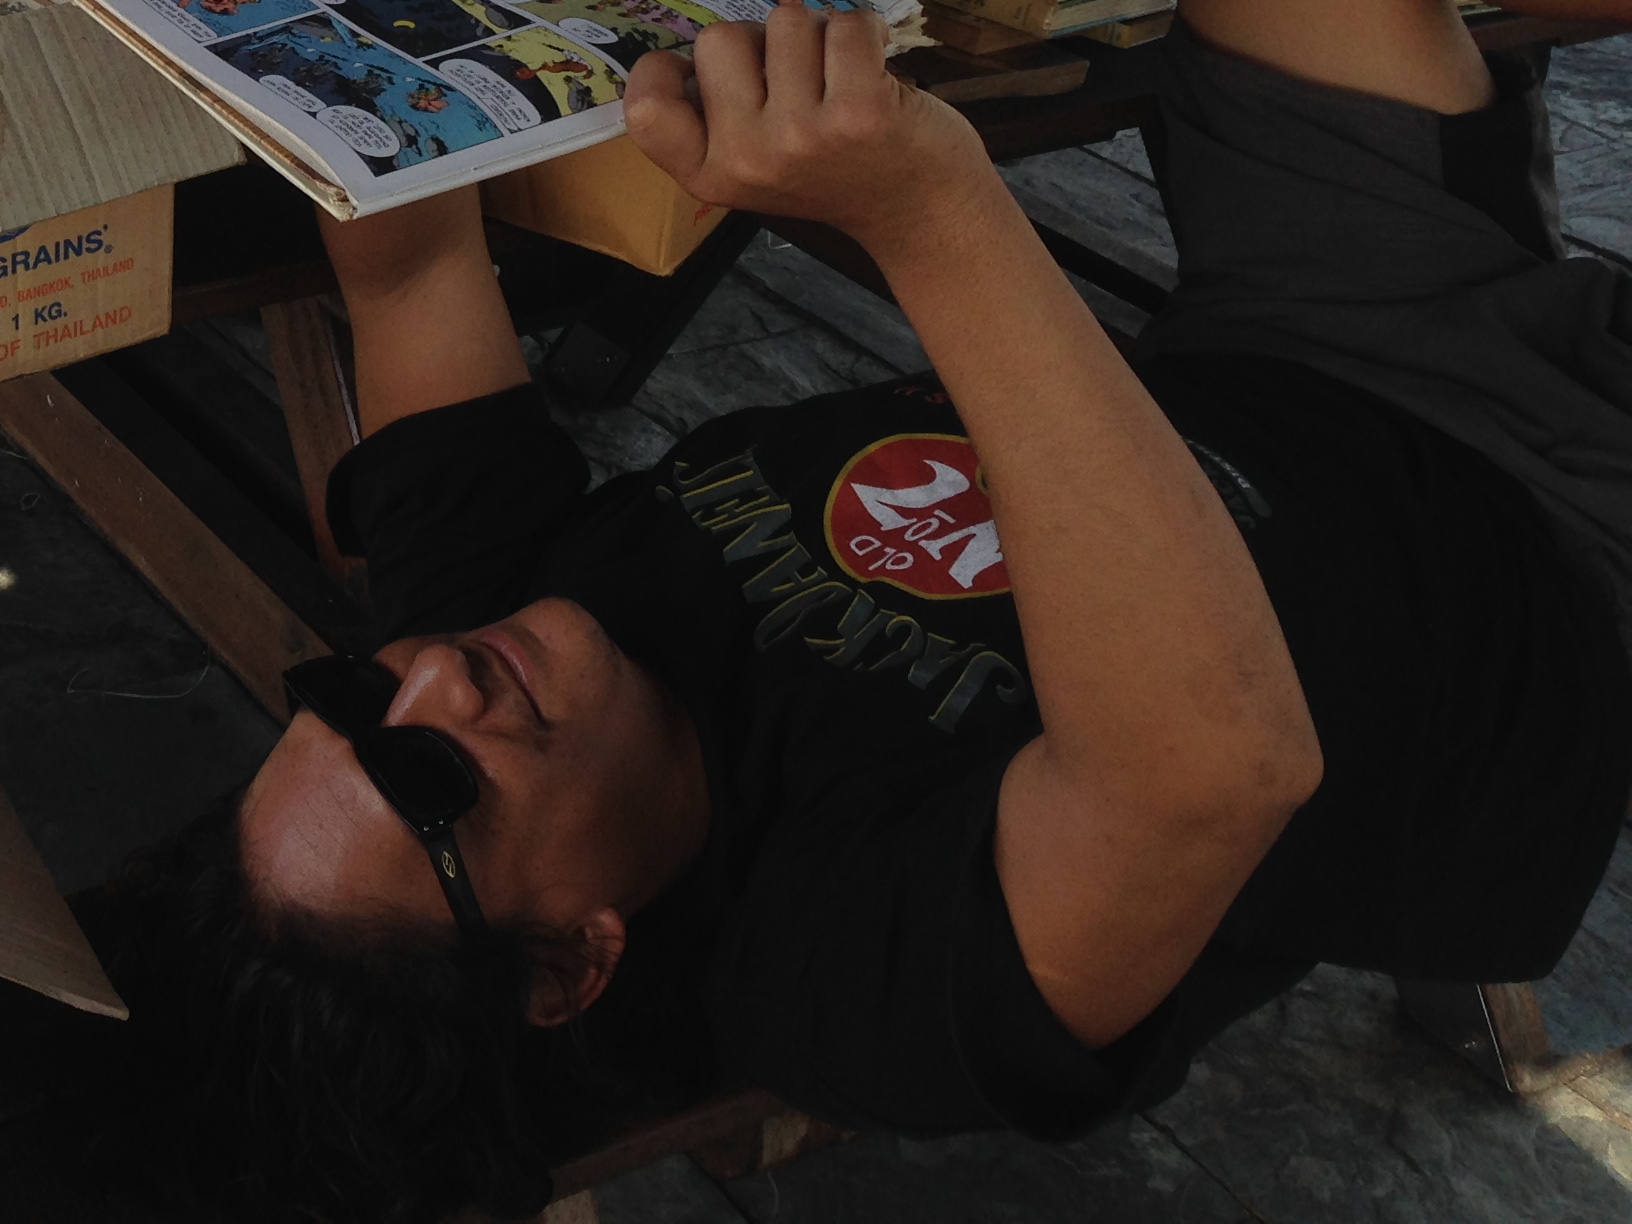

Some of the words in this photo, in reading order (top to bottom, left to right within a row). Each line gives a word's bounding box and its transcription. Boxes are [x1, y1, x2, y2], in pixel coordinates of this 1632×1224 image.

[80, 256, 135, 287] THAILAND
[11, 314, 21, 331] 1
[33, 300, 68, 325] KG.
[33, 305, 133, 350] THAILAND
[849, 534, 913, 572] OLD
[802, 589, 1025, 733] JACK
